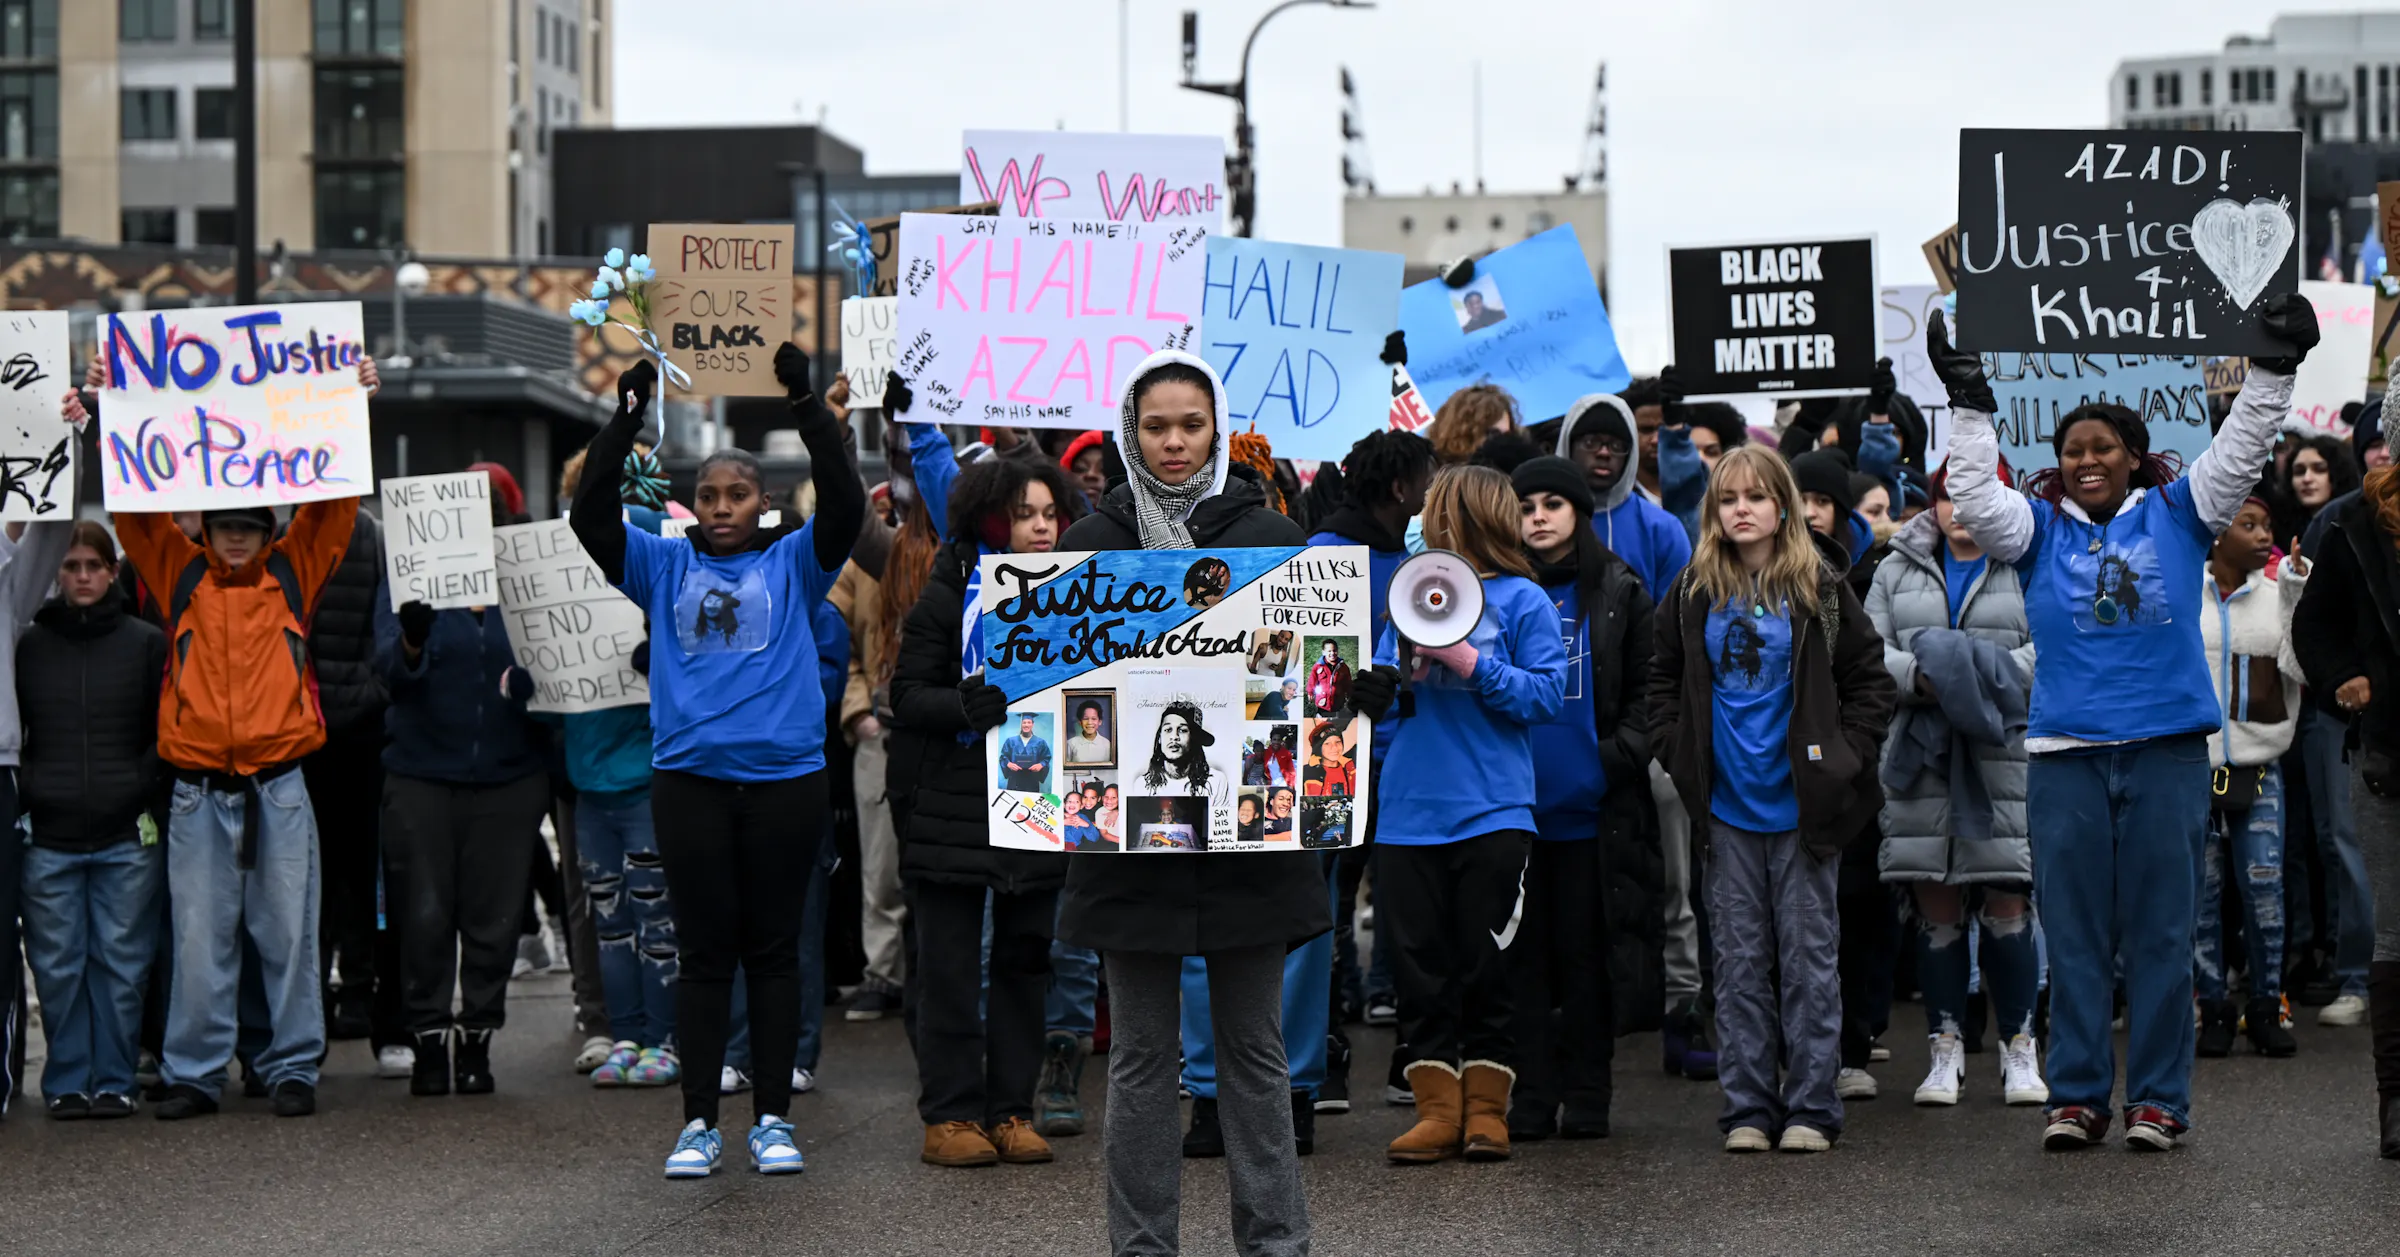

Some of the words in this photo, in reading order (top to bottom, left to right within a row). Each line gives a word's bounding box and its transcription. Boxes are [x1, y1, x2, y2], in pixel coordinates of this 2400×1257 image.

[965, 146, 1071, 218] We
[1097, 169, 1222, 222] Want
[2064, 142, 2232, 193] AZAD!
[962, 217, 998, 237] SAY
[1029, 222, 1056, 237] HIS
[1962, 152, 2196, 274] Justice
[681, 233, 783, 274] PROTECT
[1169, 226, 1188, 246] SAY
[1167, 247, 1185, 262] HIS
[1720, 246, 1824, 286] BLACK
[936, 234, 1189, 323] KHALIL
[1202, 252, 1353, 335] HALIL
[2135, 265, 2174, 300] 4
[690, 289, 755, 319] OUR
[1731, 290, 1816, 330] LIVES
[223, 311, 365, 387] Justice
[672, 322, 766, 351] BLACK
[869, 337, 897, 361] FO
[899, 348, 914, 373] SAY
[913, 327, 932, 349] HIS
[1161, 332, 1177, 350] AY
[1714, 333, 1836, 375] MATTER
[695, 351, 751, 373] BOYS
[904, 344, 940, 386] NAME
[958, 333, 1155, 409] AZAD
[2203, 355, 2250, 391] zad
[926, 379, 952, 397] SAY
[1211, 342, 1340, 430] ZAD
[983, 404, 1006, 421] SAY
[1010, 403, 1032, 420] HIS
[1038, 405, 1074, 419] NAME
[385, 482, 426, 509] WE
[433, 479, 488, 501] WILL
[405, 506, 470, 547] NOT
[394, 550, 426, 578] BE
[493, 526, 583, 569] RELE
[409, 568, 494, 602] SILENT
[497, 572, 547, 606] THE
[557, 564, 611, 593] TA
[1284, 559, 1365, 584] #LLKSL
[995, 559, 1177, 623] Justice
[1260, 582, 1265, 602] I
[1311, 586, 1349, 603] YOU
[520, 602, 592, 643] END
[1262, 607, 1348, 627] FOREVER
[519, 630, 632, 674] POLICE
[987, 624, 1059, 670] for
[1061, 617, 1164, 668] Khalil
[1031, 804, 1049, 820] LIVES
[1035, 796, 1056, 816] BLACK
[1214, 809, 1229, 818] SAY
[1214, 819, 1229, 827] HIS
[1031, 815, 1055, 834] MATTER
